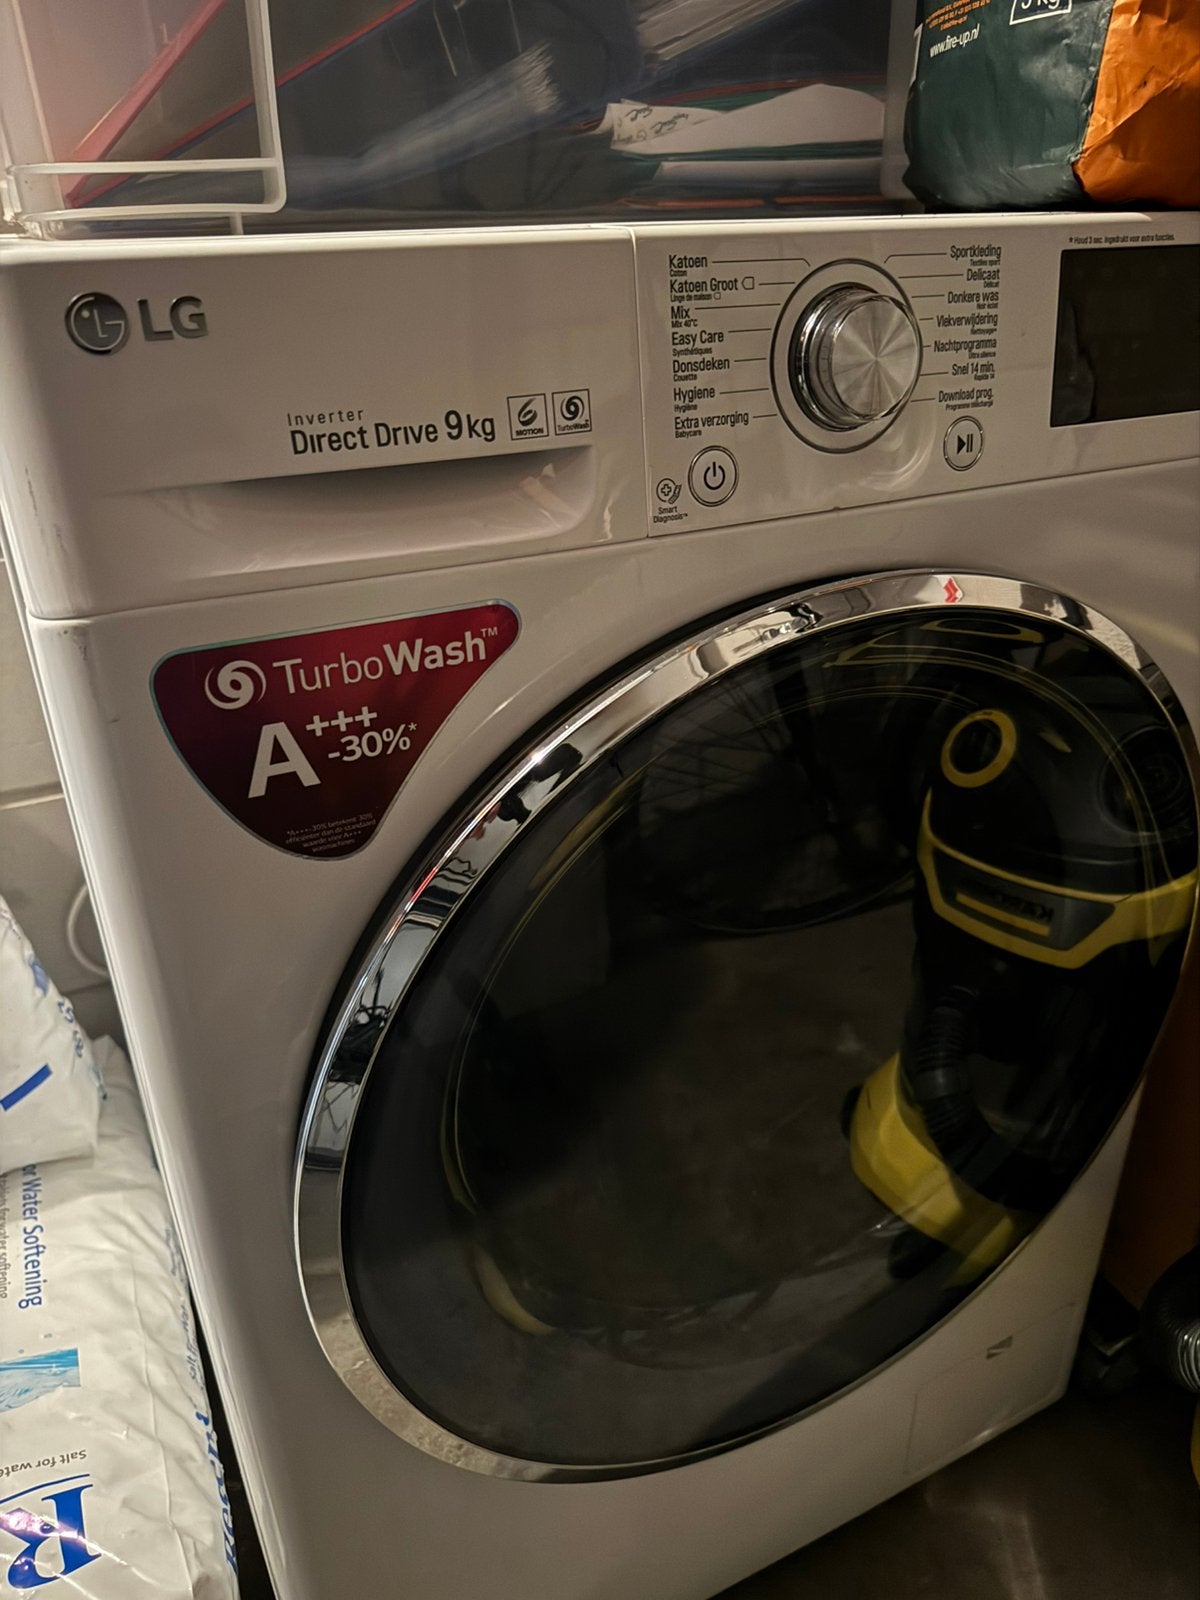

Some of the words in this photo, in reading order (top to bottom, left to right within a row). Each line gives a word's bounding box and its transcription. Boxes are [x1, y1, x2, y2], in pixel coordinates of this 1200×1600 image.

[930, 23, 980, 58] www.fire-up.nl
[950, 244, 1002, 260] Sportkleding
[668, 254, 708, 268] Katoen
[669, 269, 687, 277] Coton
[966, 268, 1000, 281] Delicaat
[670, 280, 708, 293] Katoen
[710, 277, 738, 292] Groot
[948, 290, 980, 304] Donkere
[982, 291, 999, 302] was
[136, 296, 208, 342] LG
[671, 306, 690, 320] Mix
[936, 312, 998, 328] Vlekverwijdering
[671, 319, 682, 328] Mix
[684, 318, 698, 328] 40°C
[672, 332, 698, 348] Easy
[700, 330, 724, 344] Care
[934, 339, 996, 354] Nachtprogramma
[672, 357, 730, 373] Donsdeken
[952, 362, 969, 376] Snel
[970, 362, 979, 374] 14
[980, 361, 995, 373] min.
[673, 374, 697, 382] Couette
[674, 386, 715, 403] Hygiene
[938, 388, 975, 402] Download
[976, 388, 994, 401] prog.
[287, 409, 364, 426] Inverter
[675, 416, 699, 429] Extra
[701, 410, 749, 427] verzorging
[289, 426, 368, 454] Direct
[374, 422, 438, 448] Drive
[516, 427, 544, 436] MOTION
[675, 429, 702, 439] Babycare
[658, 506, 678, 514] Smart
[22, 1177, 42, 1221] Water
[18, 1225, 47, 1309] Softening
[36, 1457, 57, 1468] for
[60, 1450, 87, 1464] Salt
